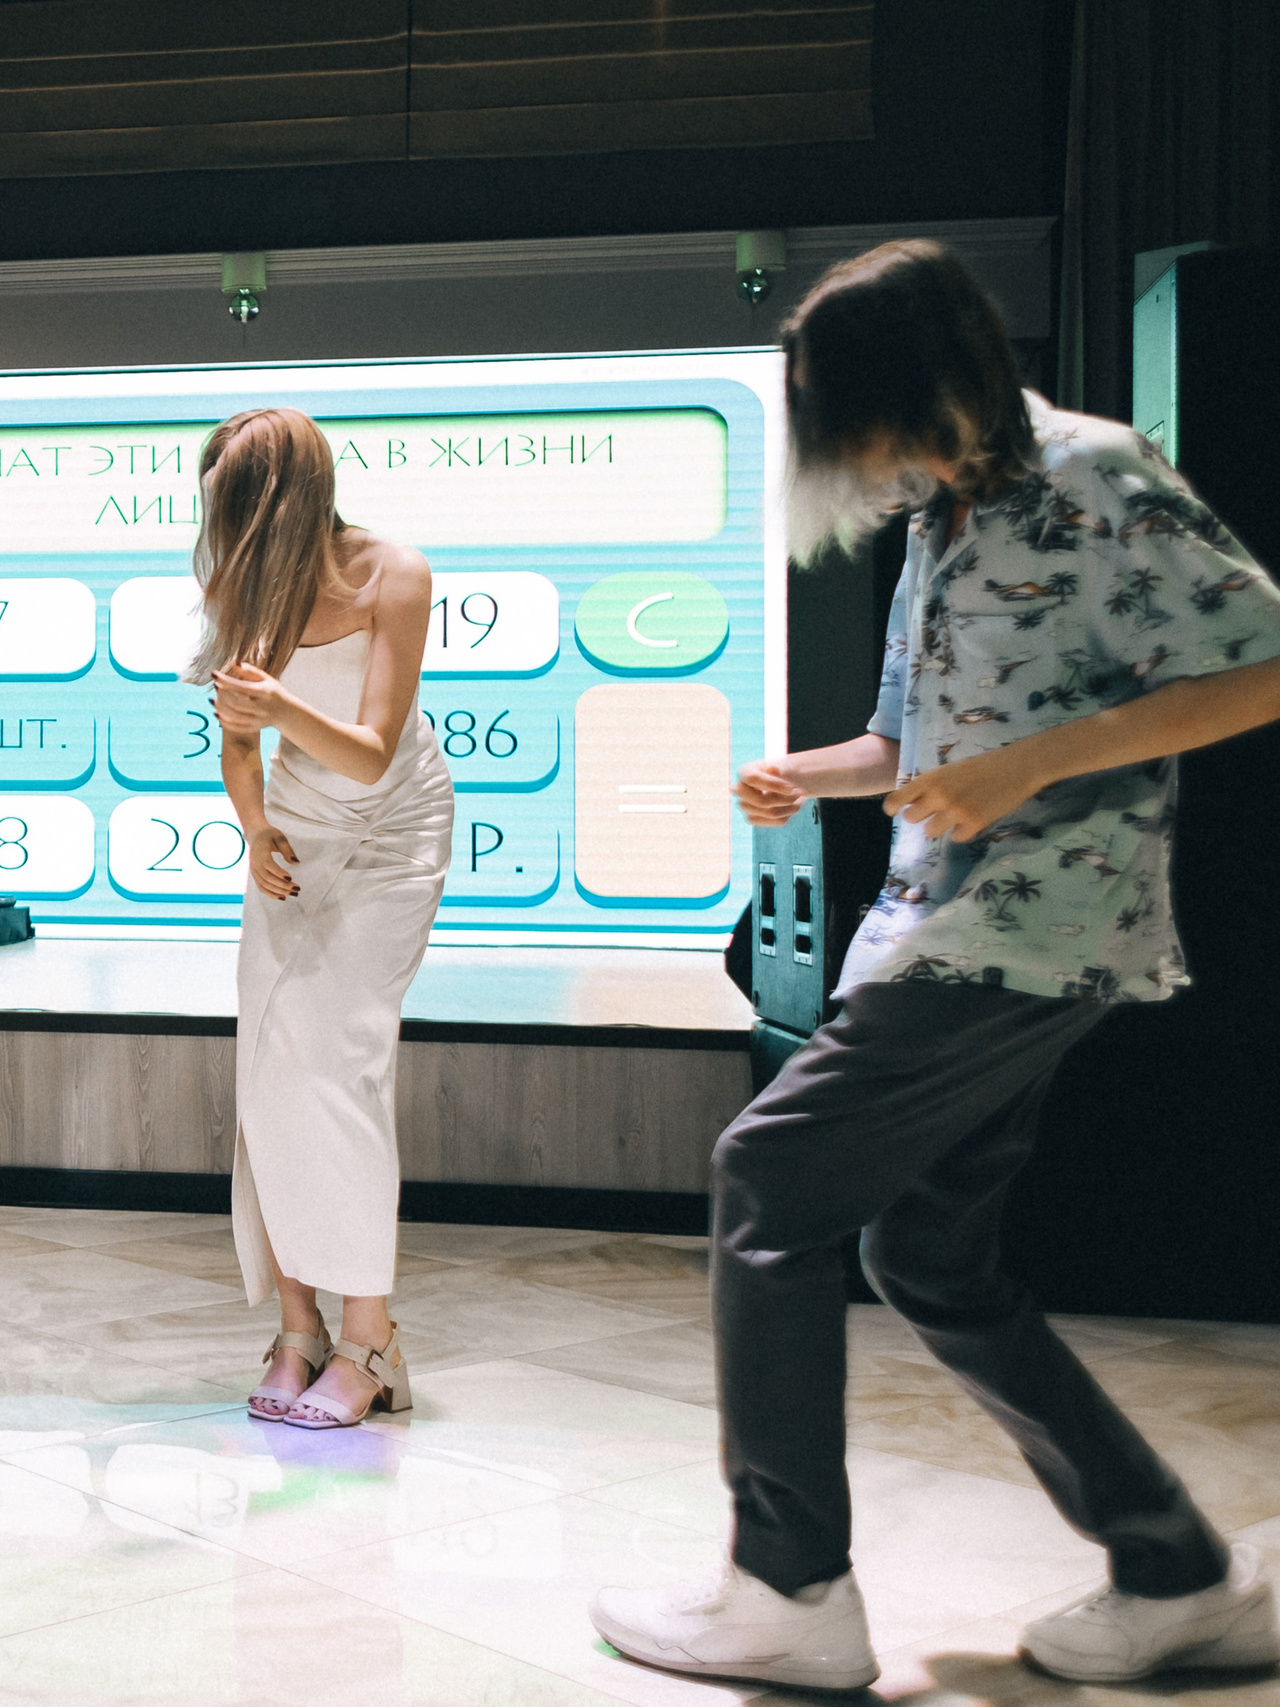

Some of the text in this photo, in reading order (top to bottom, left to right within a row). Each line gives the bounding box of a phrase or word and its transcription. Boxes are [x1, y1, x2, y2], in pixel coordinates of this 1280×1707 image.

[88, 444, 181, 476] ЭТИ
[387, 438, 407, 469] В
[428, 433, 613, 468] ЖИЗНИ
[626, 592, 679, 648] C
[183, 710, 222, 759] 3
